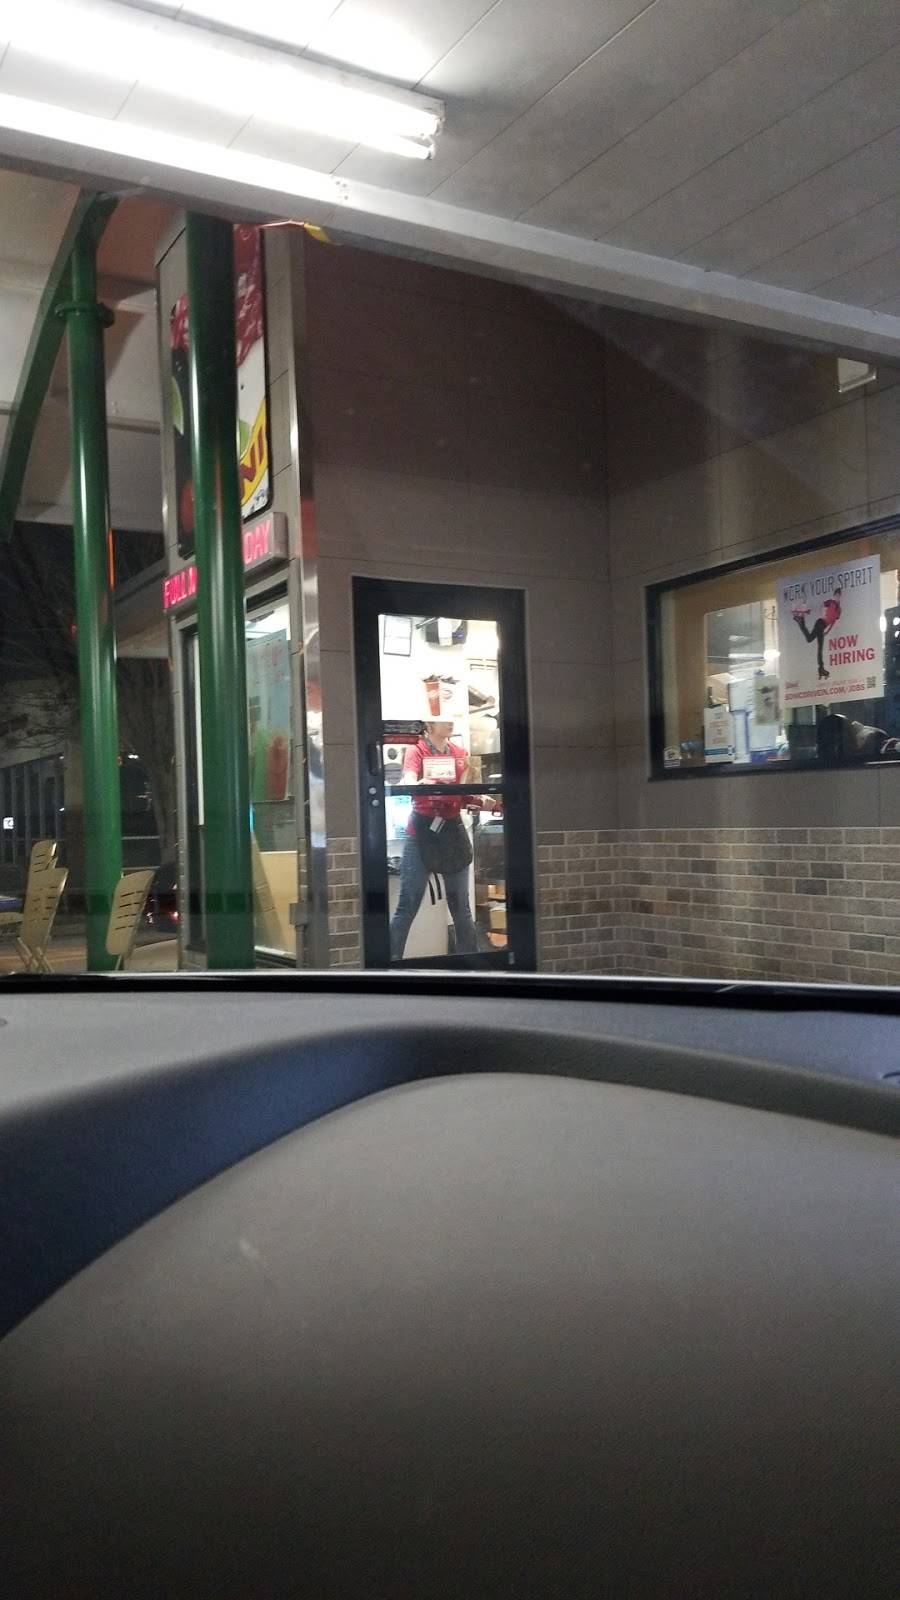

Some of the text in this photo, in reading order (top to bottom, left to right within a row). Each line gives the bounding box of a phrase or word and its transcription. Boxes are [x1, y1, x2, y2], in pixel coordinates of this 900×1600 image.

[243, 519, 271, 565] DAY
[783, 566, 873, 604] WORK YOUR SPIRIT
[829, 634, 858, 651] NOW
[829, 647, 876, 667] HIRING
